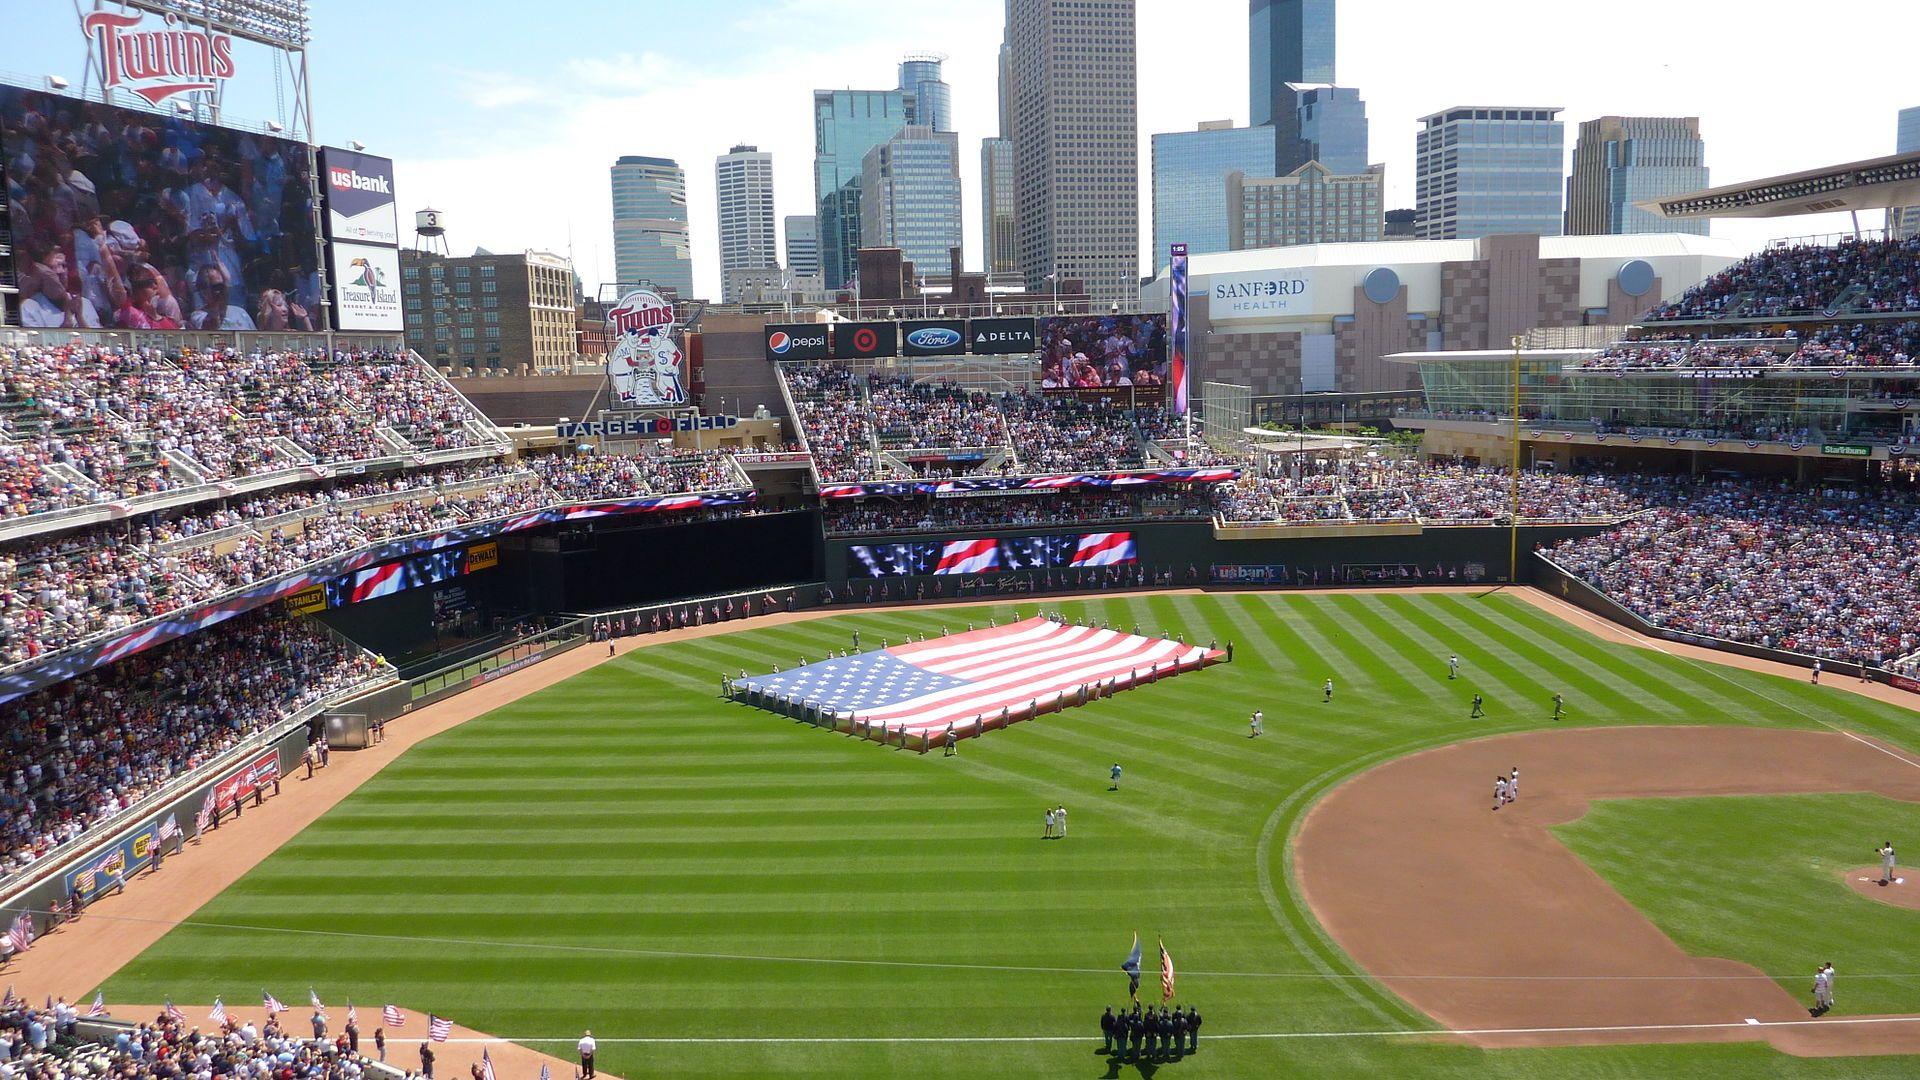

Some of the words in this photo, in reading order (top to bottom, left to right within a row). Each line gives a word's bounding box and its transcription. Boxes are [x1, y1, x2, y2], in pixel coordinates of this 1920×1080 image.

[83, 9, 235, 90] Twins
[427, 213, 437, 226] 3
[341, 286, 370, 303] Treasure
[376, 289, 397, 304] Island
[1216, 279, 1305, 299] SANFORD
[1233, 301, 1287, 311] HEALTH
[608, 303, 674, 337] Twins
[792, 335, 825, 349] pepsi
[918, 331, 949, 346] Ford
[989, 331, 1032, 342] DELTA
[555, 418, 653, 438] TARGET
[677, 415, 739, 432] FIELD
[736, 455, 761, 463] THOME
[288, 591, 322, 608] STANLEY
